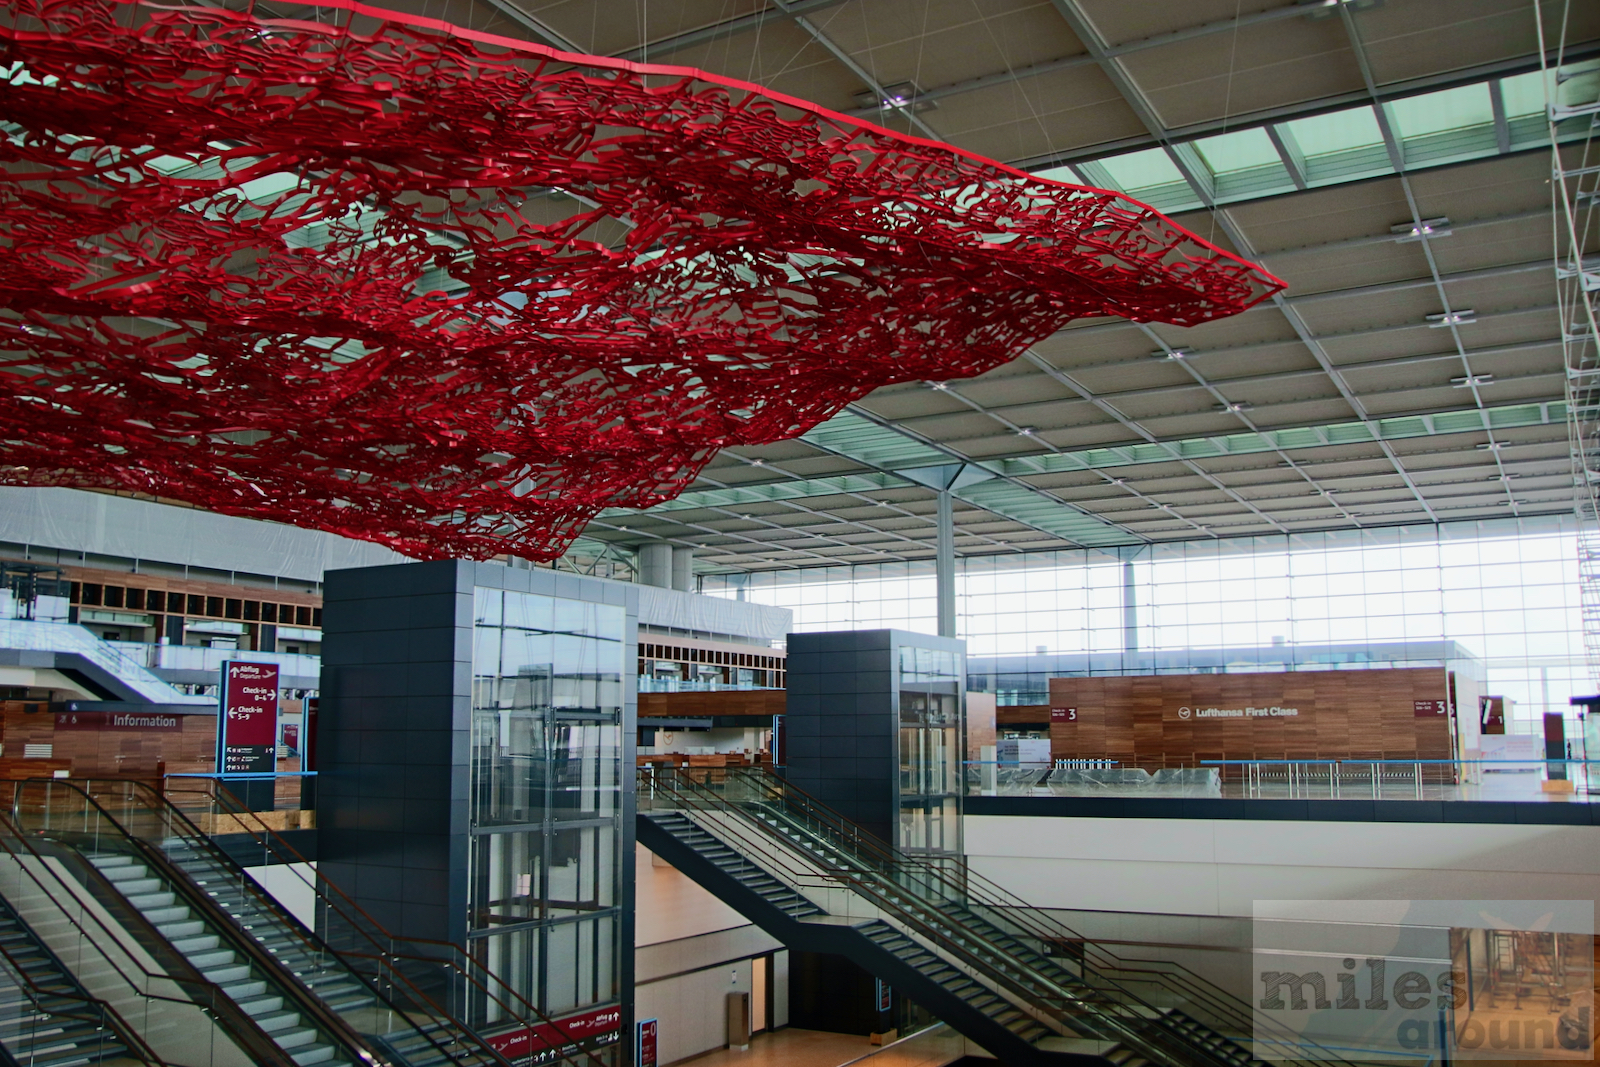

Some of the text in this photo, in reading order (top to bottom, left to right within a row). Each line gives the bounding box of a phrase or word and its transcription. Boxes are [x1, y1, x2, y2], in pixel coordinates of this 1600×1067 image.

[240, 666, 260, 674] Abflug
[1196, 706, 1298, 718] Lufthansa First Class
[1436, 701, 1446, 714] 3
[1068, 708, 1076, 720] 3
[114, 714, 176, 728] Information
[569, 1020, 585, 1029] Check-in
[650, 1022, 656, 1036] 0
[510, 1034, 528, 1044] Check-in
